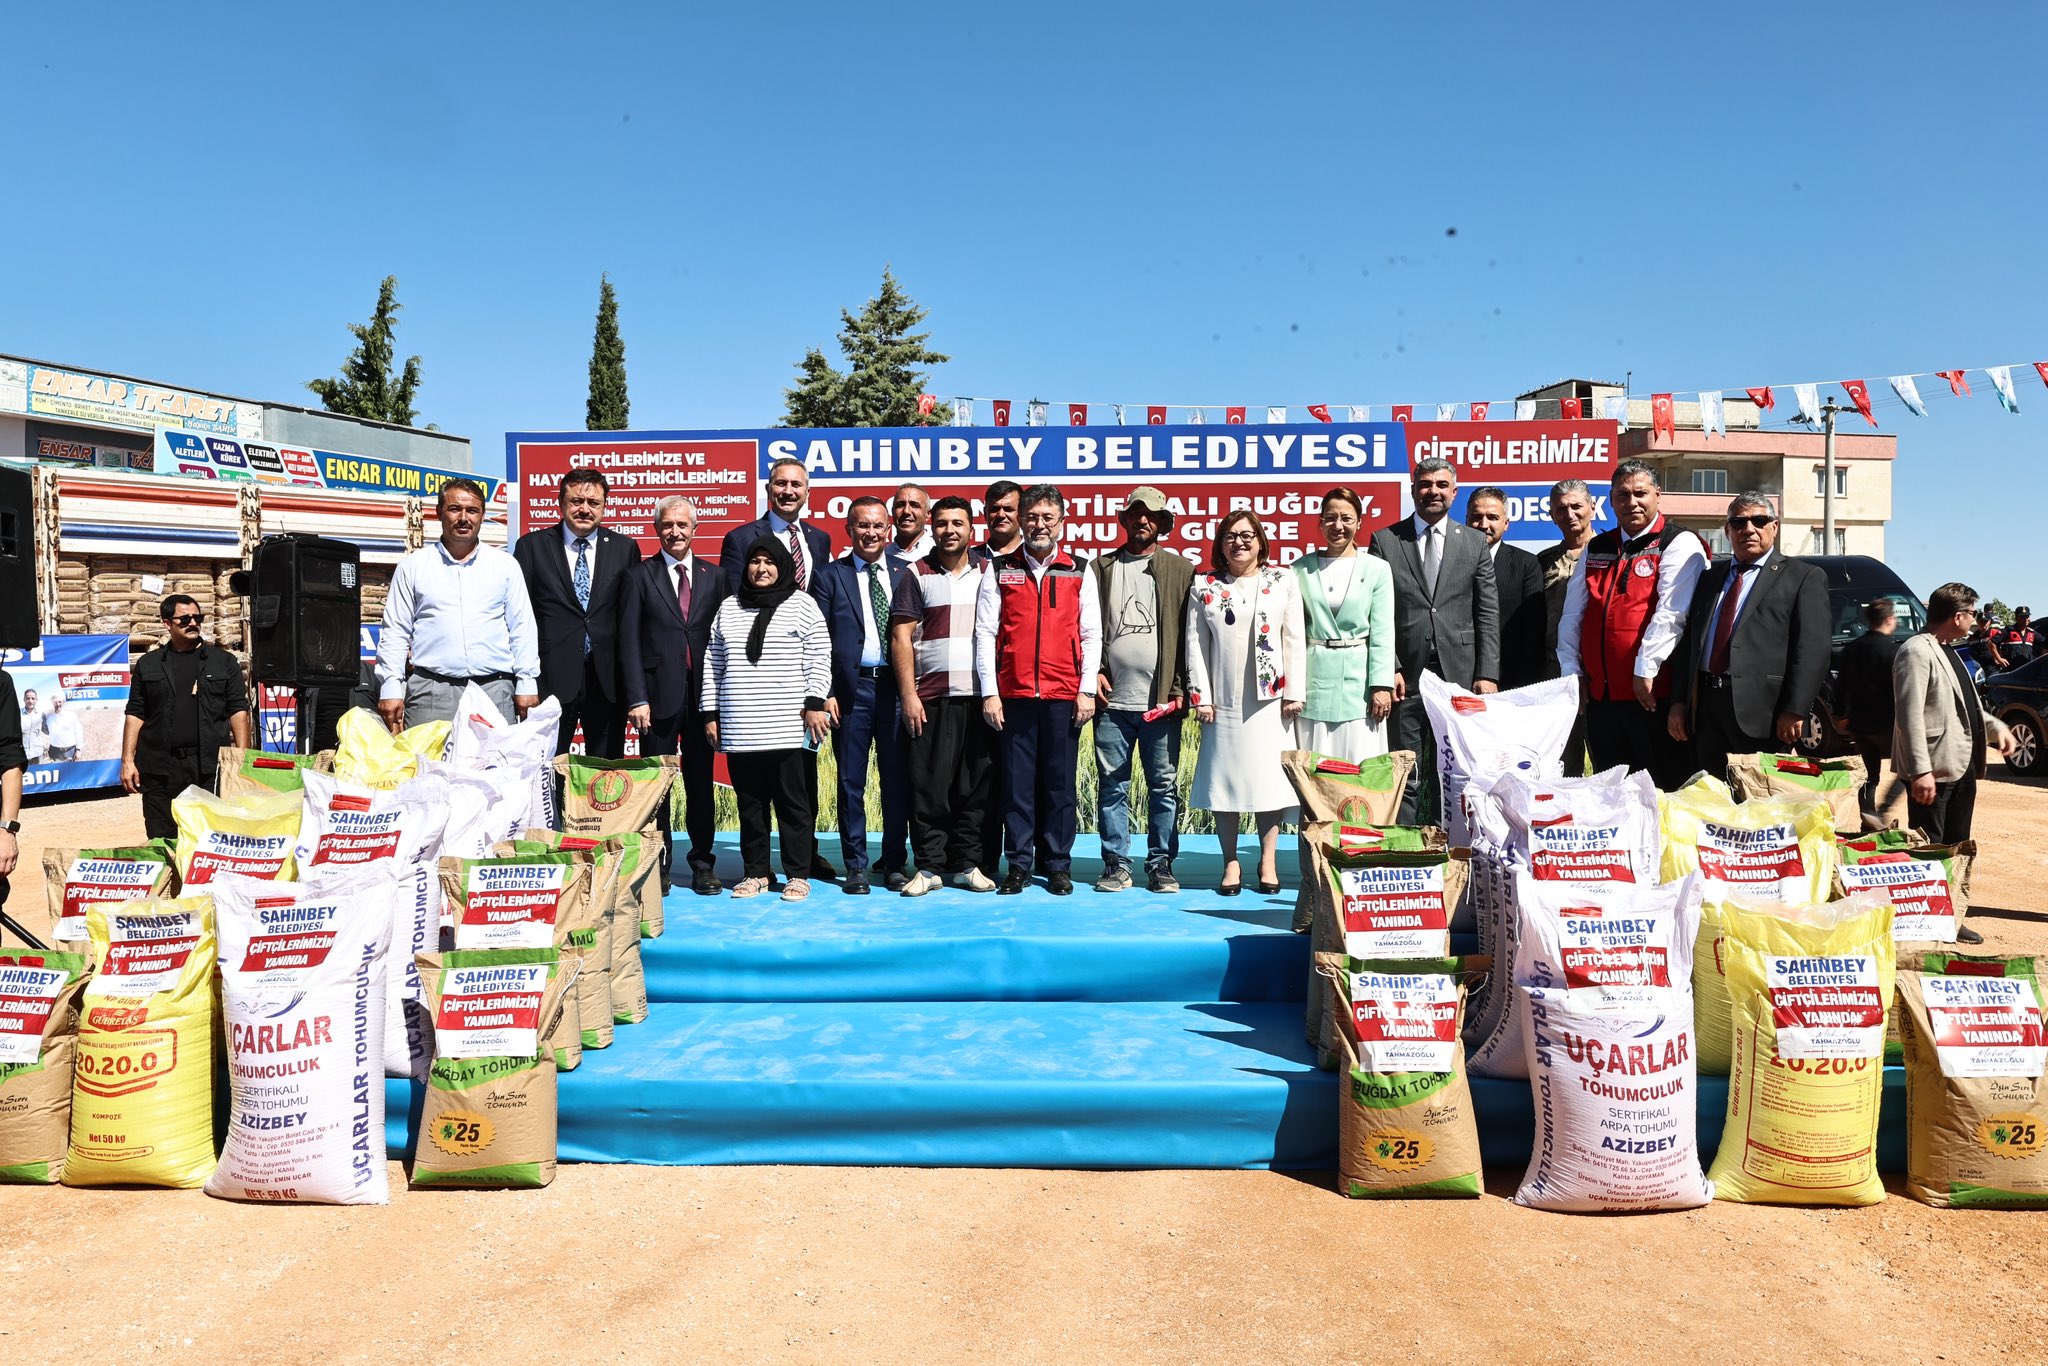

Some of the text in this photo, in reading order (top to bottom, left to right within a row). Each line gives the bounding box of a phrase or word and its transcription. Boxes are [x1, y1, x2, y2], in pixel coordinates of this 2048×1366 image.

[32, 369, 128, 408] ENSAR
[186, 438, 195, 447] EL
[213, 442, 235, 453] KAZMA
[38, 440, 92, 461] ENSAR
[175, 447, 206, 460] ALETLERİ
[1414, 432, 1610, 469] ÇİFTÇİLERİMİZE
[220, 453, 241, 464] KÜREK
[569, 451, 705, 470] ÇİFTÇİLERİMİZE VE
[326, 457, 420, 491] ENSAR KUM
[705, 494, 750, 506] MERCİMEK,
[1229, 492, 1382, 518] BUĞDY,
[620, 510, 630, 518] ve
[1508, 495, 1607, 522] DESK
[1181, 519, 1298, 541] GÜRE
[63, 673, 122, 687] ÇİFTÇİLERİMİZE
[67, 689, 99, 699] DESTEK
[327, 850, 371, 861] YANINDA
[1556, 869, 1612, 879] YANINDA
[1724, 868, 1779, 880] YANINDA
[1347, 895, 1442, 914] ÇİFTÇİLERİMİZİN
[487, 908, 532, 922] YANINDA
[1370, 915, 1423, 928] YANINDA
[128, 958, 172, 973] YANINDA
[264, 954, 308, 968] YANINDA
[1774, 988, 1878, 1008] ÇİFTÇİLERİMİZİN
[463, 1013, 514, 1027] YANINDA
[227, 1015, 333, 1060] UÇARLAR
[1380, 1024, 1436, 1038] YANINDA
[1962, 1030, 2022, 1043] YANINDA
[1736, 1028, 1744, 1065] 20.20.0
[1385, 1050, 1435, 1058] TAHMAZOĞLU
[1563, 1031, 1689, 1078] UÇARLAR
[77, 1052, 157, 1076] 20.20.0
[231, 1057, 320, 1080] TOHUMCULUK
[1529, 959, 1554, 1196] UÇARLAR TOHUMCULUK
[1353, 1079, 1407, 1100] BUĞDAY
[1579, 1077, 1684, 1102] TOHUMCULUK
[262, 1096, 309, 1111] TOHUMU
[353, 1071, 373, 1188] UÇARLAR
[1600, 1117, 1678, 1134] ARPA TOHUMU
[89, 1133, 126, 1145] Net 50 kg
[293, 1172, 312, 1181] UÇAR
[1612, 1172, 1630, 1180] Kahta
[244, 1187, 298, 1200] NET: 50 KG
